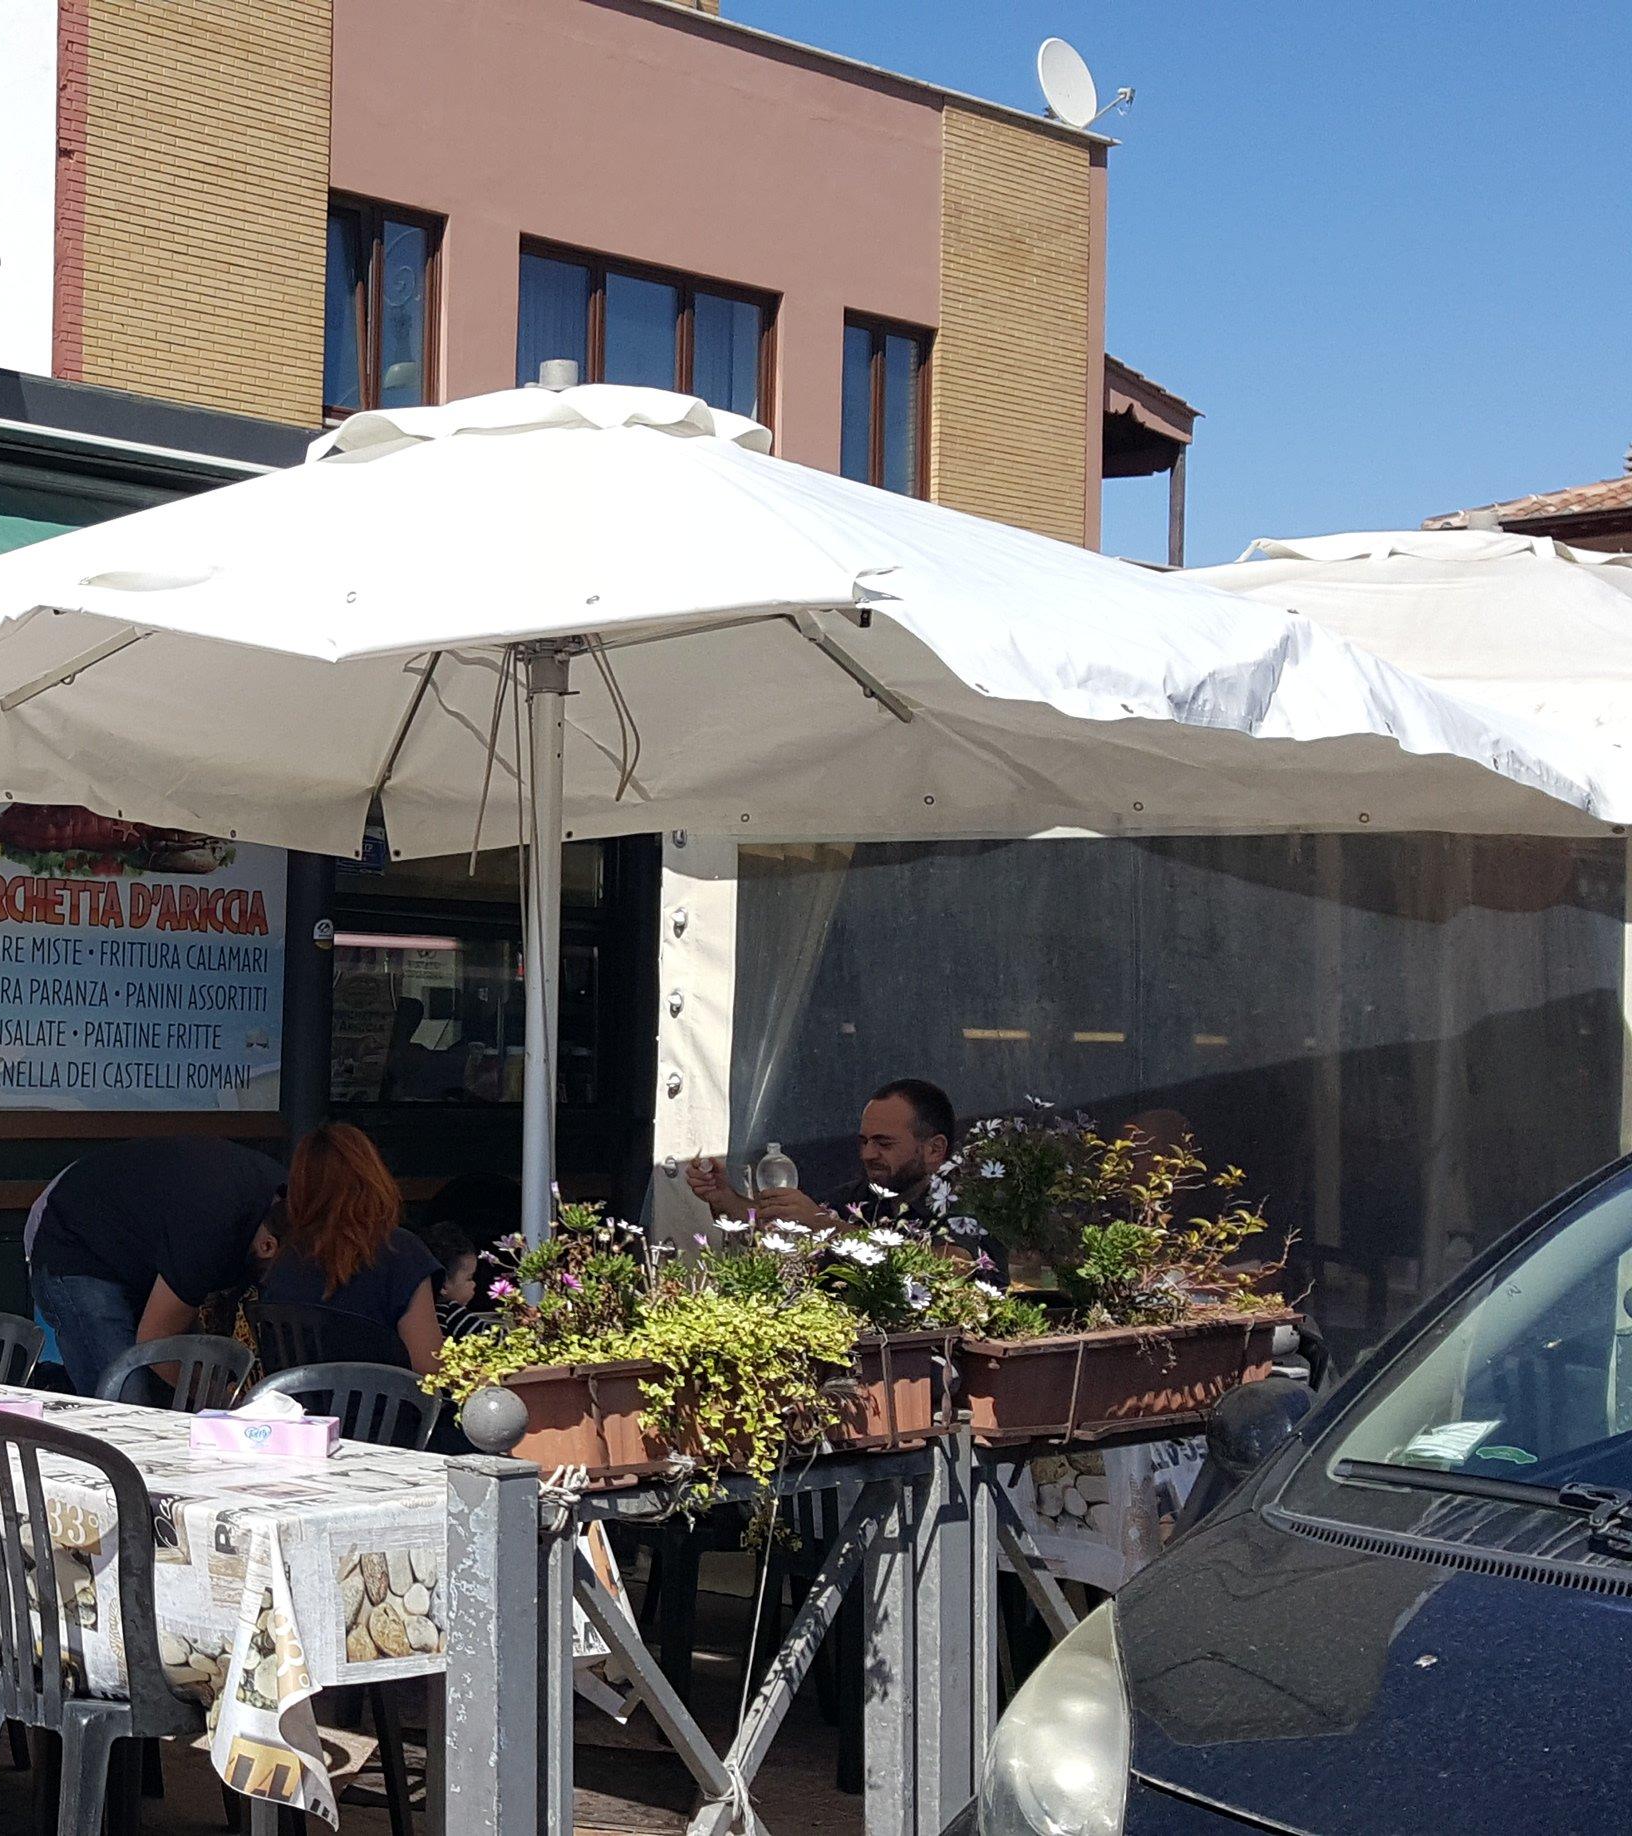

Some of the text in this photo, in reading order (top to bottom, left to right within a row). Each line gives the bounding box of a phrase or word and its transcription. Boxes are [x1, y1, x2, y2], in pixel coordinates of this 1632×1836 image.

[129, 882, 270, 936] D'ARICCIA
[31, 936, 85, 966] MISTE
[100, 940, 182, 970] FRITTURA
[186, 945, 270, 974] CALAMARI
[29, 978, 110, 1008] PARANZA
[126, 982, 183, 1010] PANINI
[188, 984, 269, 1012] ASSORTITI
[84, 1021, 162, 1049] PATATINE
[167, 1023, 222, 1050] FRITTE
[67, 1061, 97, 1088] DEI
[102, 1062, 181, 1090] CASTELLI
[187, 1064, 252, 1090] ROMANI
